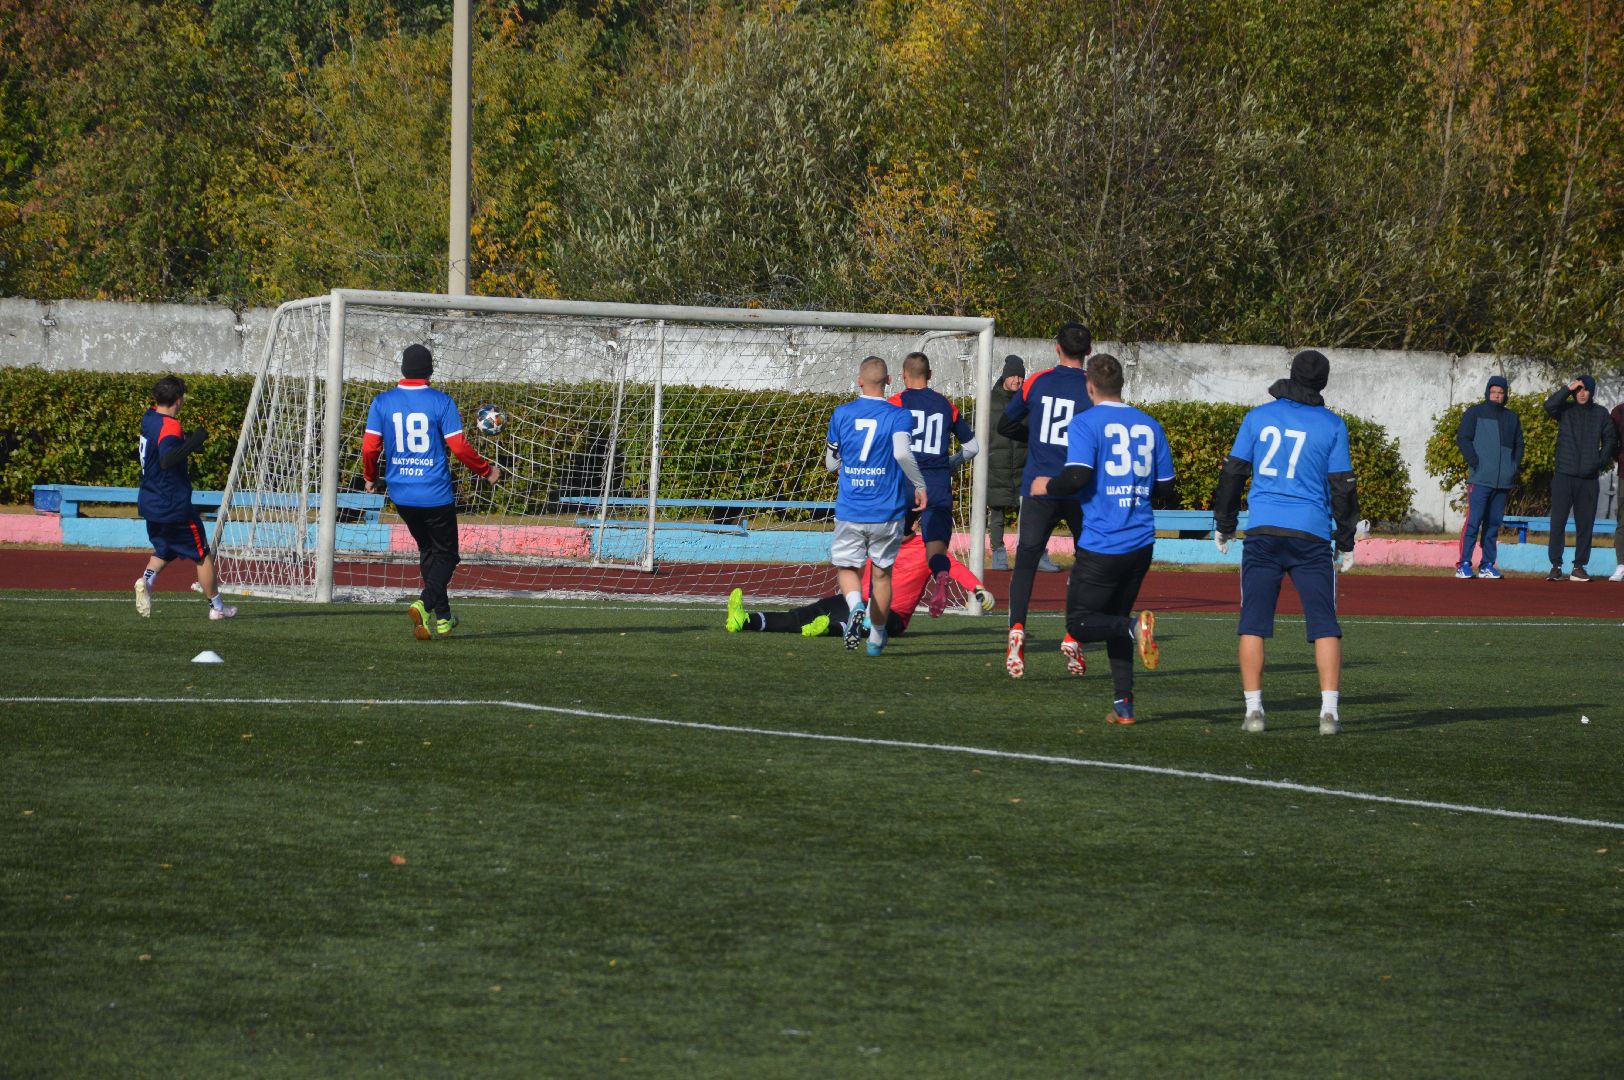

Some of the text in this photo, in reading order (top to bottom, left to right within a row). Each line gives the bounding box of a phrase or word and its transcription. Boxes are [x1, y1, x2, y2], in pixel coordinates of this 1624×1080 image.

[392, 412, 430, 453] 18
[855, 418, 877, 461] 7
[910, 409, 943, 454] 20
[1040, 395, 1075, 446] 12
[392, 457, 433, 466] ШАТУРСКОЕ
[400, 467, 414, 476] ПТО
[845, 466, 886, 475] ШАТУРСКОЕ
[1104, 423, 1155, 477] 33
[1258, 425, 1307, 479] 27
